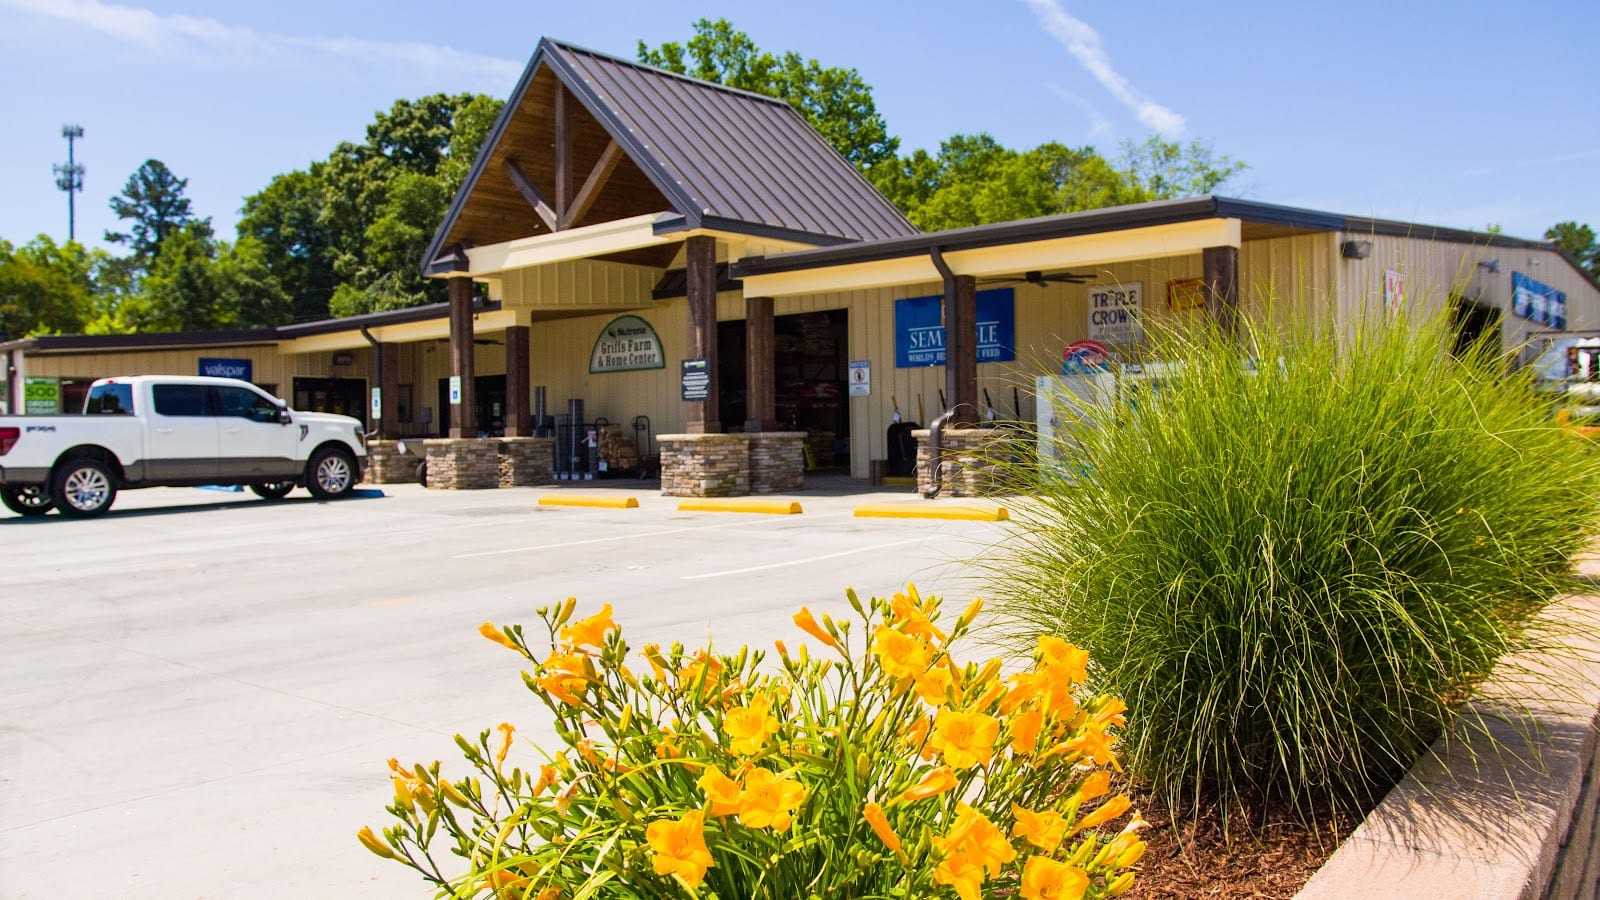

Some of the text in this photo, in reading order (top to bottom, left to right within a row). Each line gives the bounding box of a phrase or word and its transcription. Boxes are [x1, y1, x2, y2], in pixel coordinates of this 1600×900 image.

[1092, 289, 1137, 308] TRPLE
[618, 327, 646, 336] Nutrena
[910, 324, 998, 349] SEMLE
[602, 339, 652, 354] Griffs Farm
[982, 348, 1001, 358] FEED
[598, 352, 656, 368] & Home Center
[204, 363, 247, 377] valspar
[26, 387, 56, 398] SOD
